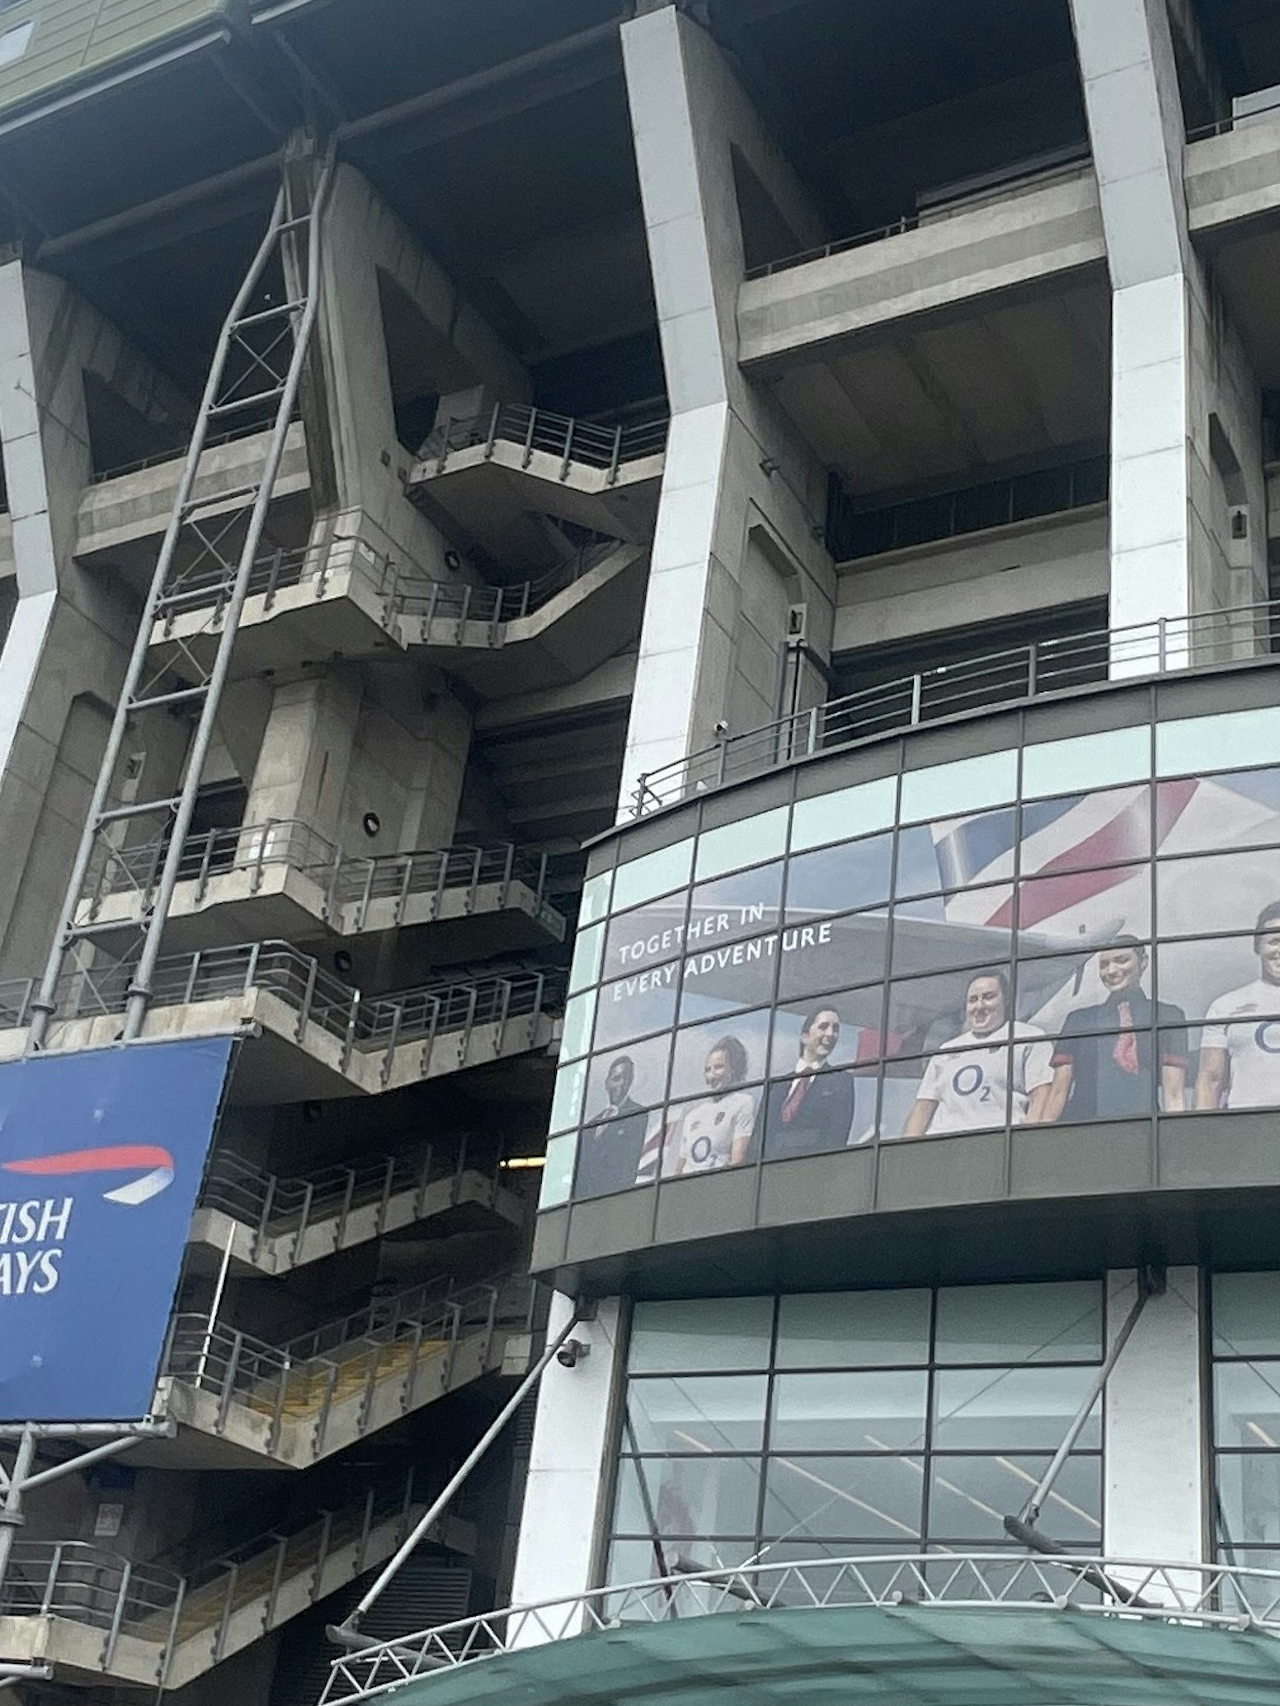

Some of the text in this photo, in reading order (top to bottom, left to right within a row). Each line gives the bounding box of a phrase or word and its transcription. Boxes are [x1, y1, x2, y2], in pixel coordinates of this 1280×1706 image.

[612, 923, 832, 1002] EVERY ADVENTURE
[619, 902, 765, 964] TOGETHER IN
[952, 1064, 991, 1102] O2
